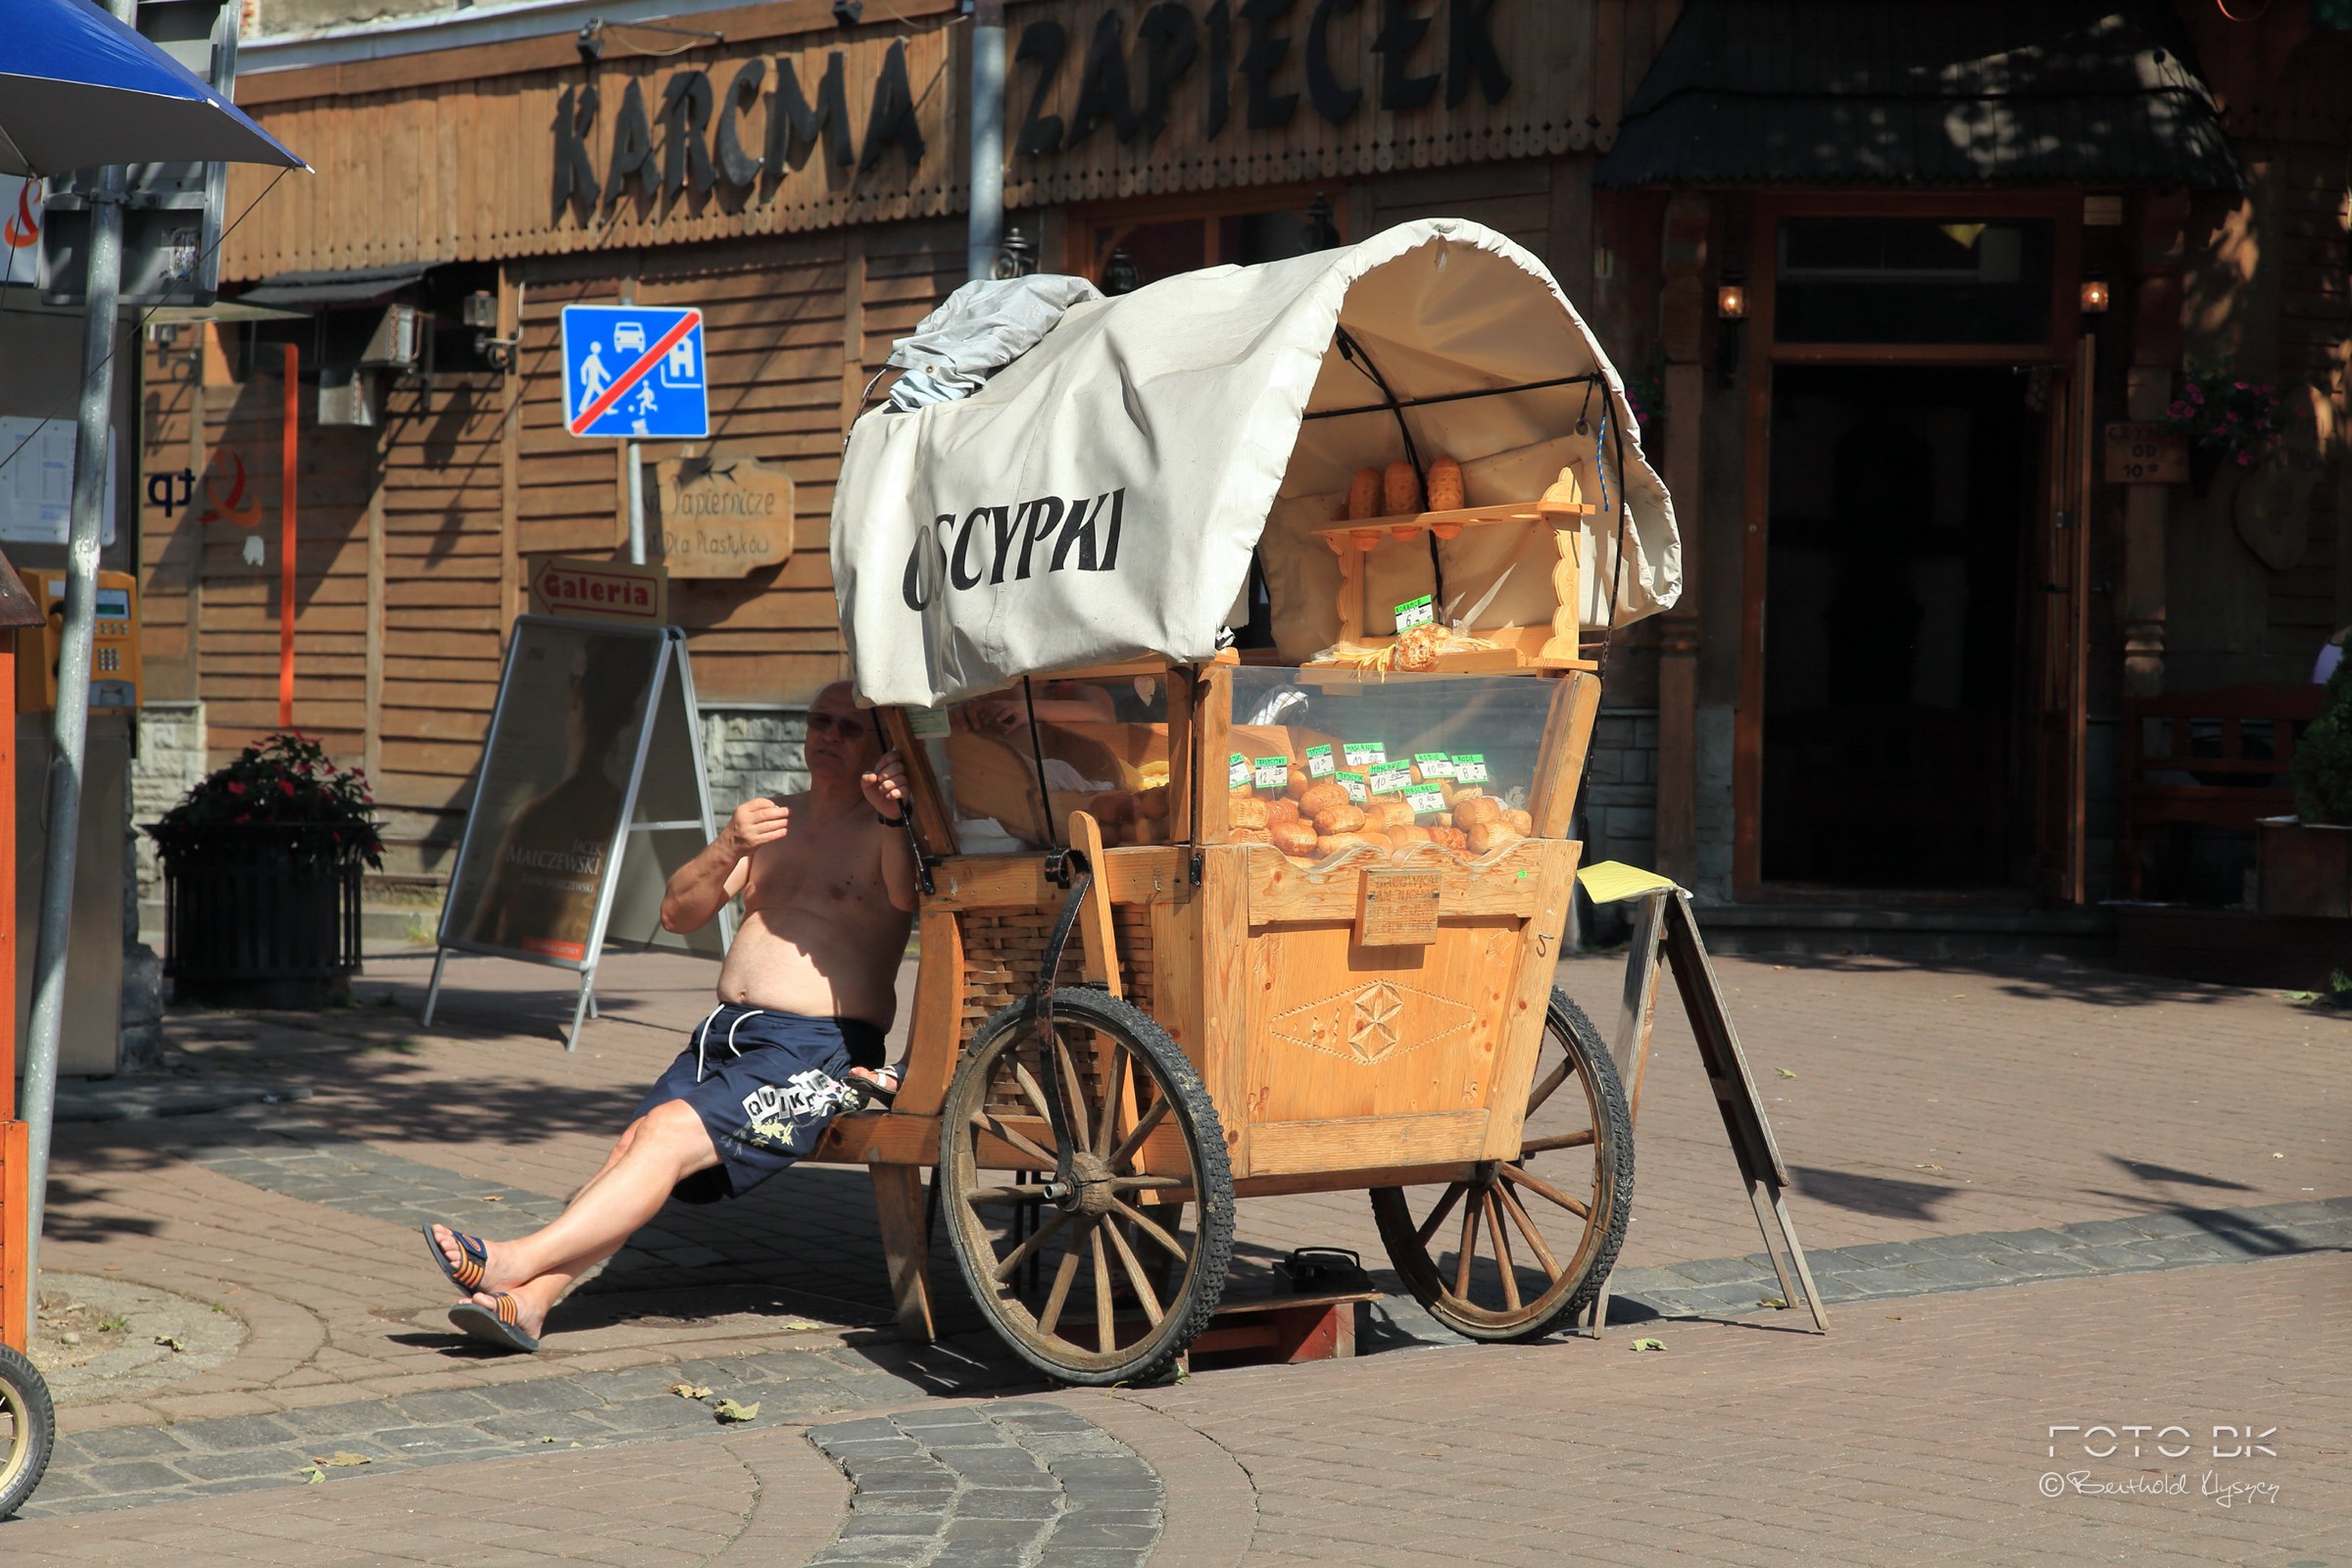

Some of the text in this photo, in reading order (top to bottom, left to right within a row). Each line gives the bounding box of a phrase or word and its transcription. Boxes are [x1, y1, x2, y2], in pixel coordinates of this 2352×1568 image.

[551, 0, 1512, 208] KARCMA ZAPIECEK
[2132, 444, 2157, 457] OD
[903, 487, 1126, 612] OSCYPKI
[544, 573, 648, 606] Galeria
[506, 846, 601, 875] MALCZEWSKI
